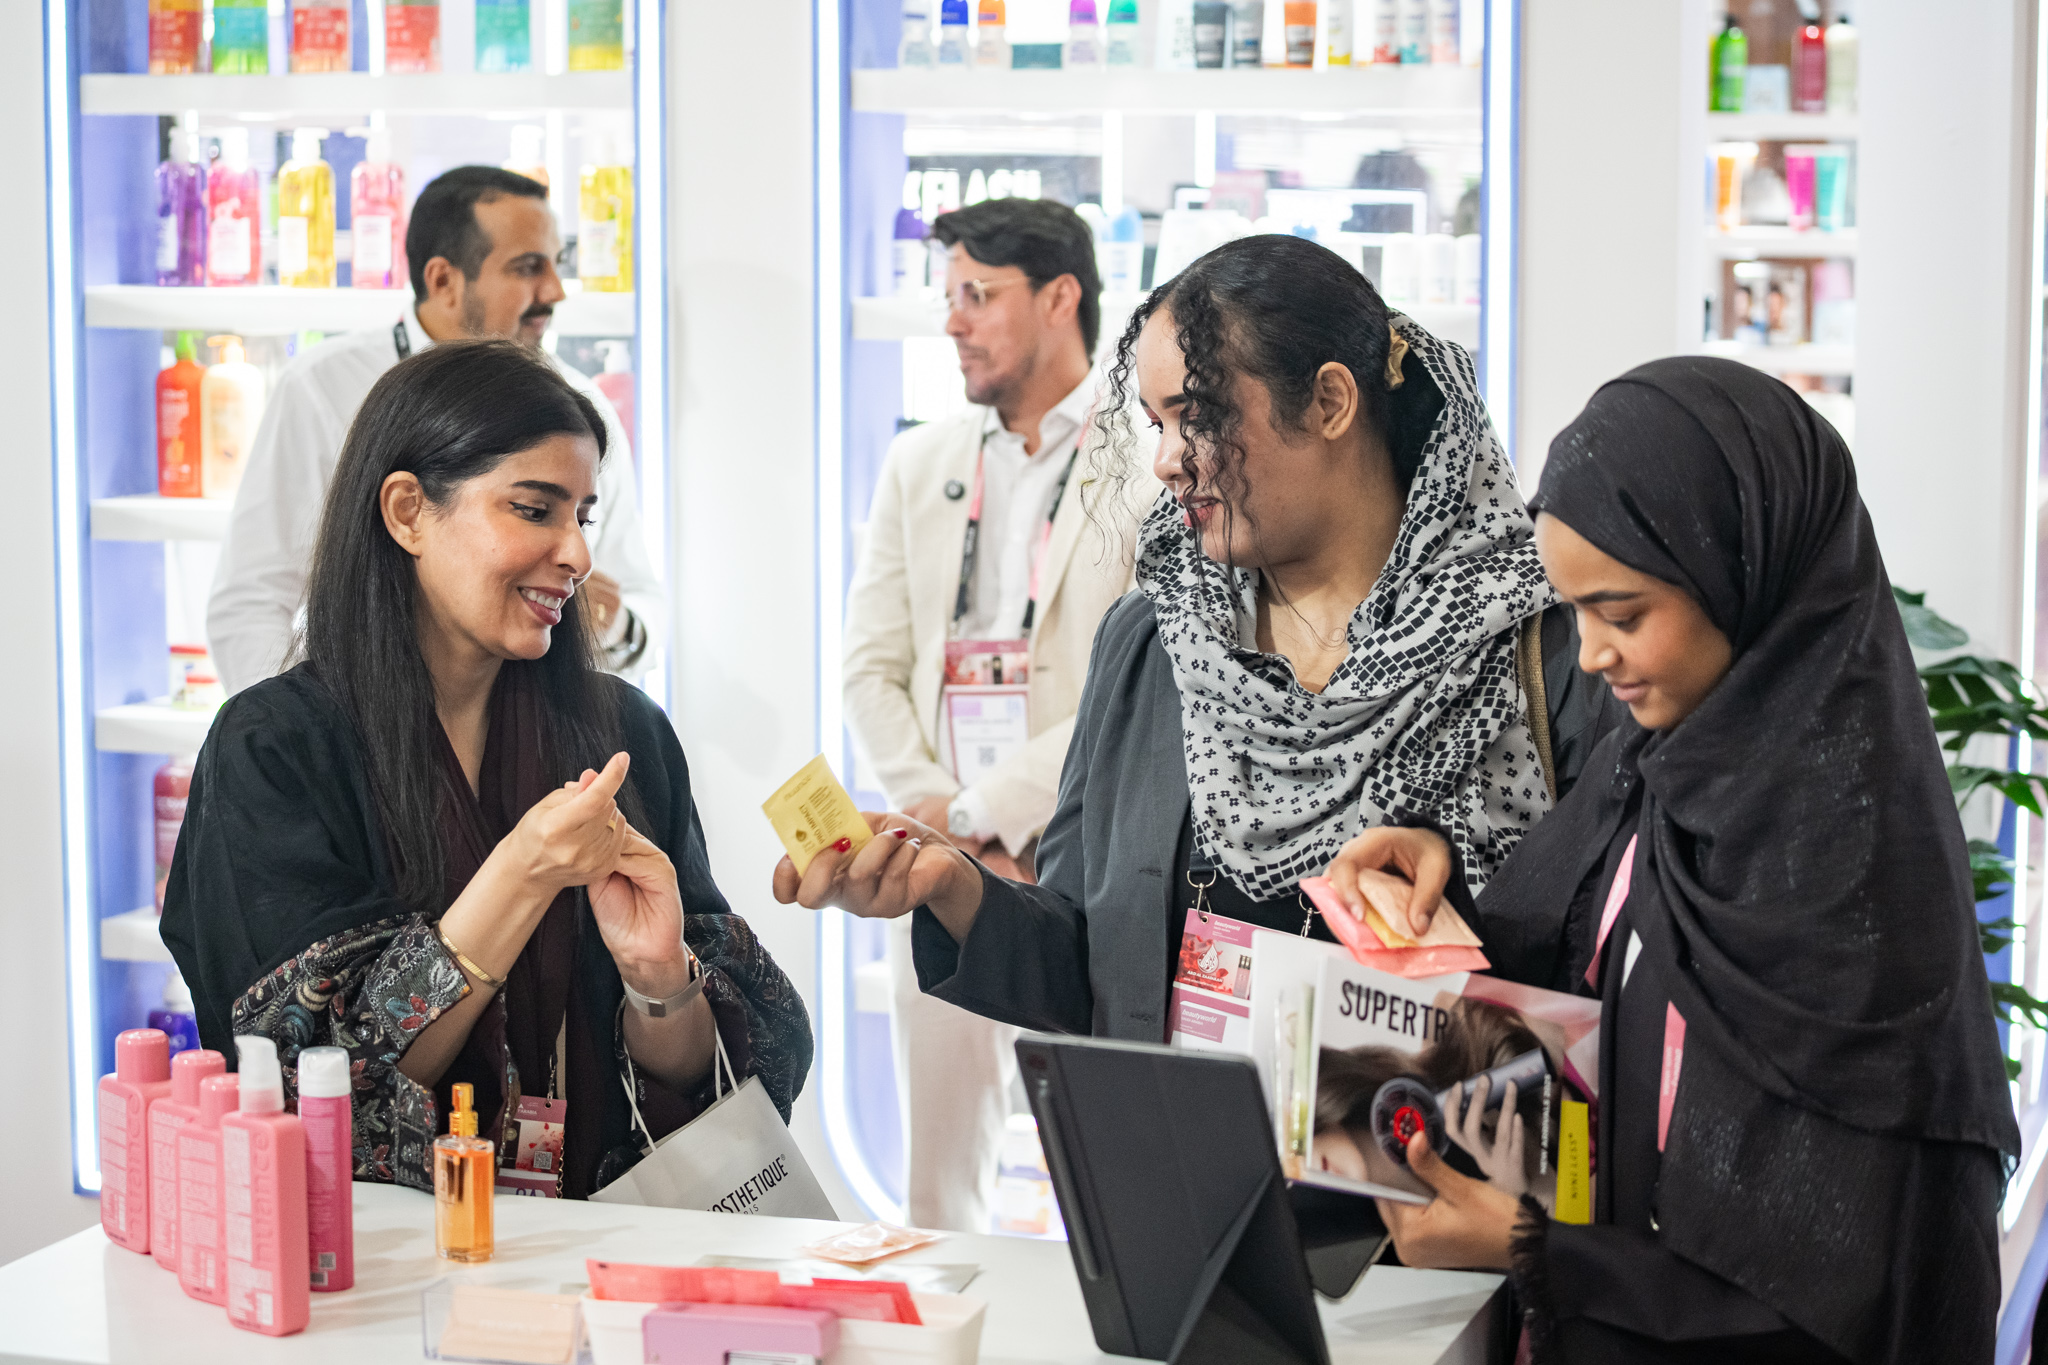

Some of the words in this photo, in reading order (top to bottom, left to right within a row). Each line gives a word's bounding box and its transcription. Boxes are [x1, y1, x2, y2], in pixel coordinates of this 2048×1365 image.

[799, 804, 818, 830] IMPACT
[813, 829, 826, 844] PRO
[1182, 1009, 1217, 1023] beautyworld
[1339, 979, 1449, 1042] SUPERTR
[1539, 1098, 1551, 1148] ARRIVALS
